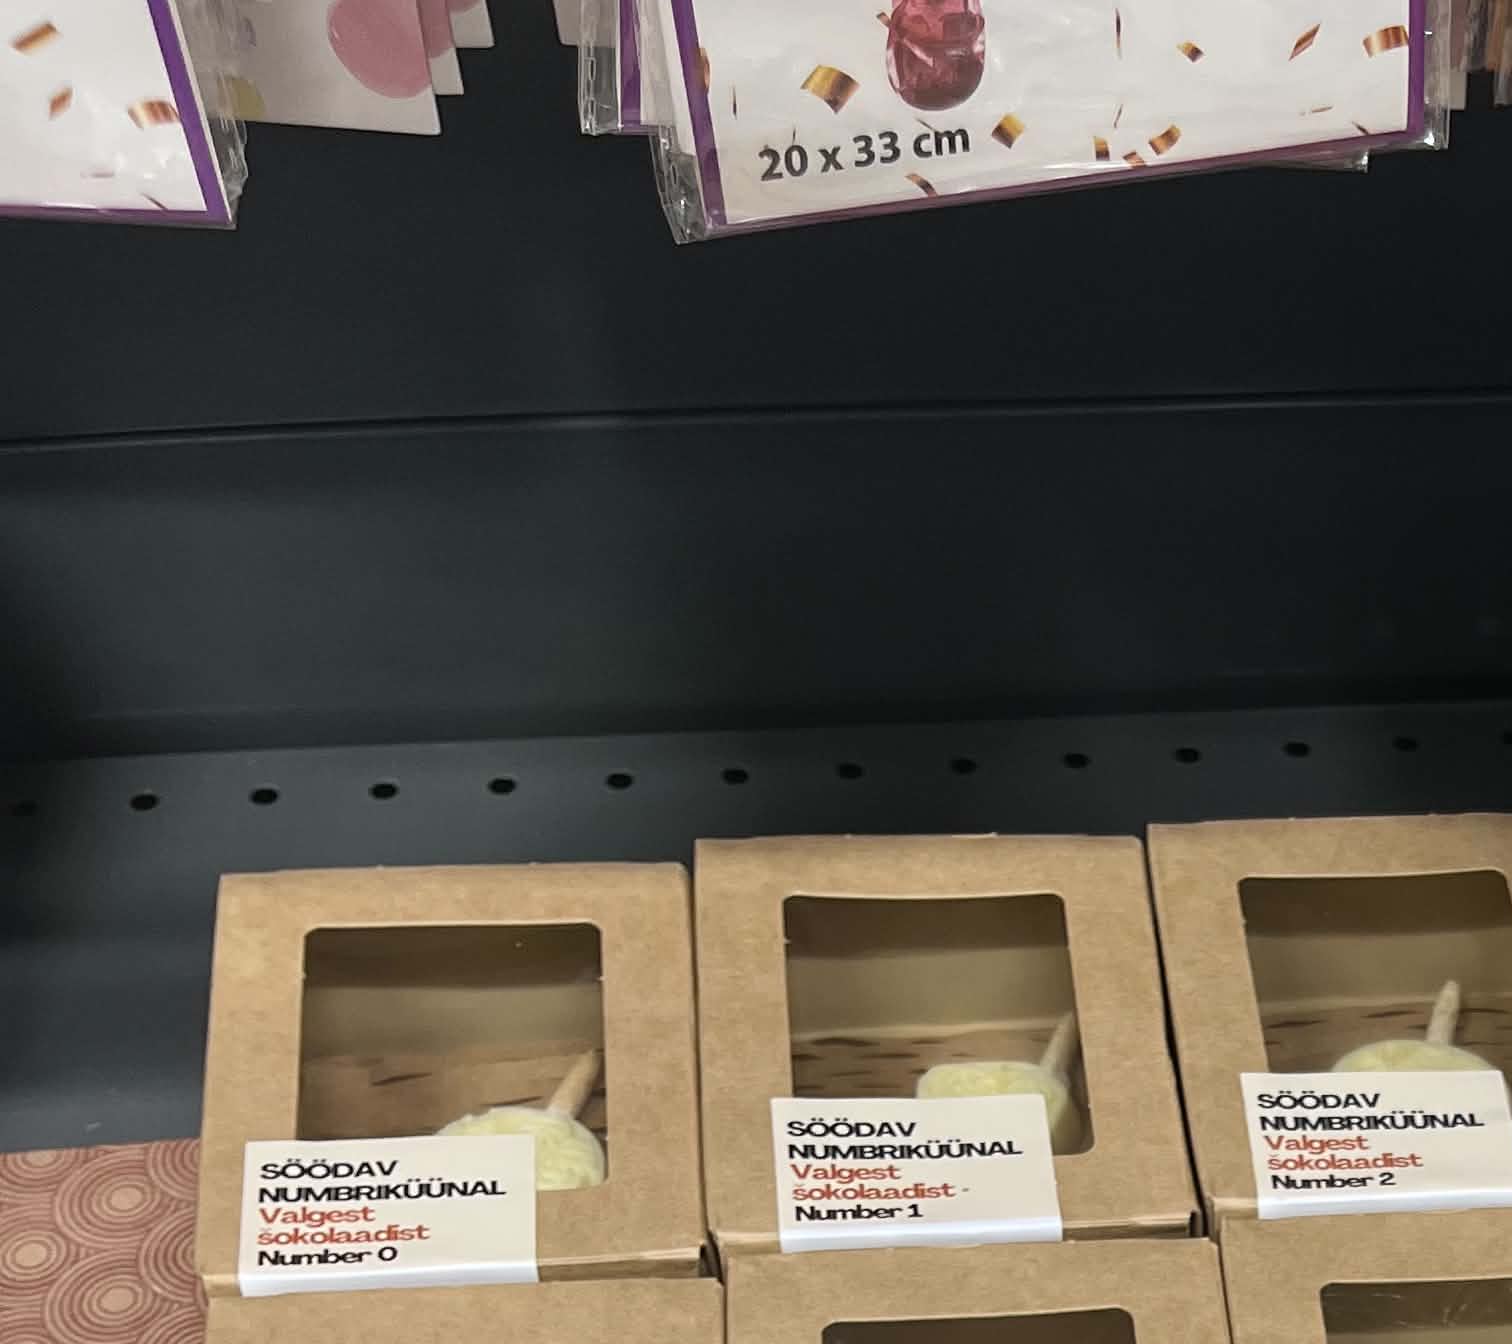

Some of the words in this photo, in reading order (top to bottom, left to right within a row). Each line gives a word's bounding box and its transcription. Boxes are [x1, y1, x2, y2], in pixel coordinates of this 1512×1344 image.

[759, 146, 807, 181] 20
[819, 146, 845, 172] x
[853, 131, 903, 167] 33
[913, 128, 970, 159] cm
[1256, 1090, 1381, 1110] SÖÖDAV
[786, 1117, 917, 1138] SÖÖDAV
[1258, 1109, 1486, 1132] NUMBRIKÜÜNAL
[787, 1138, 1024, 1161] NUMBRIKÜÜNAL
[1263, 1134, 1370, 1153] Valgest
[259, 1157, 399, 1180] SÖÖDAV
[1267, 1151, 1424, 1171] šokolaadist
[789, 1163, 902, 1182] Valgest
[1270, 1173, 1375, 1190] Number
[1378, 1171, 1397, 1187] 2
[258, 1176, 508, 1204] NUMBRIKÜÜNAL
[792, 1180, 956, 1201] šokolaadist
[259, 1205, 376, 1227] Valgest
[794, 1203, 904, 1222] Number
[907, 1203, 924, 1219] 1
[257, 1224, 430, 1246] šokolaadist
[257, 1248, 373, 1267] Number
[377, 1245, 399, 1262] 0
